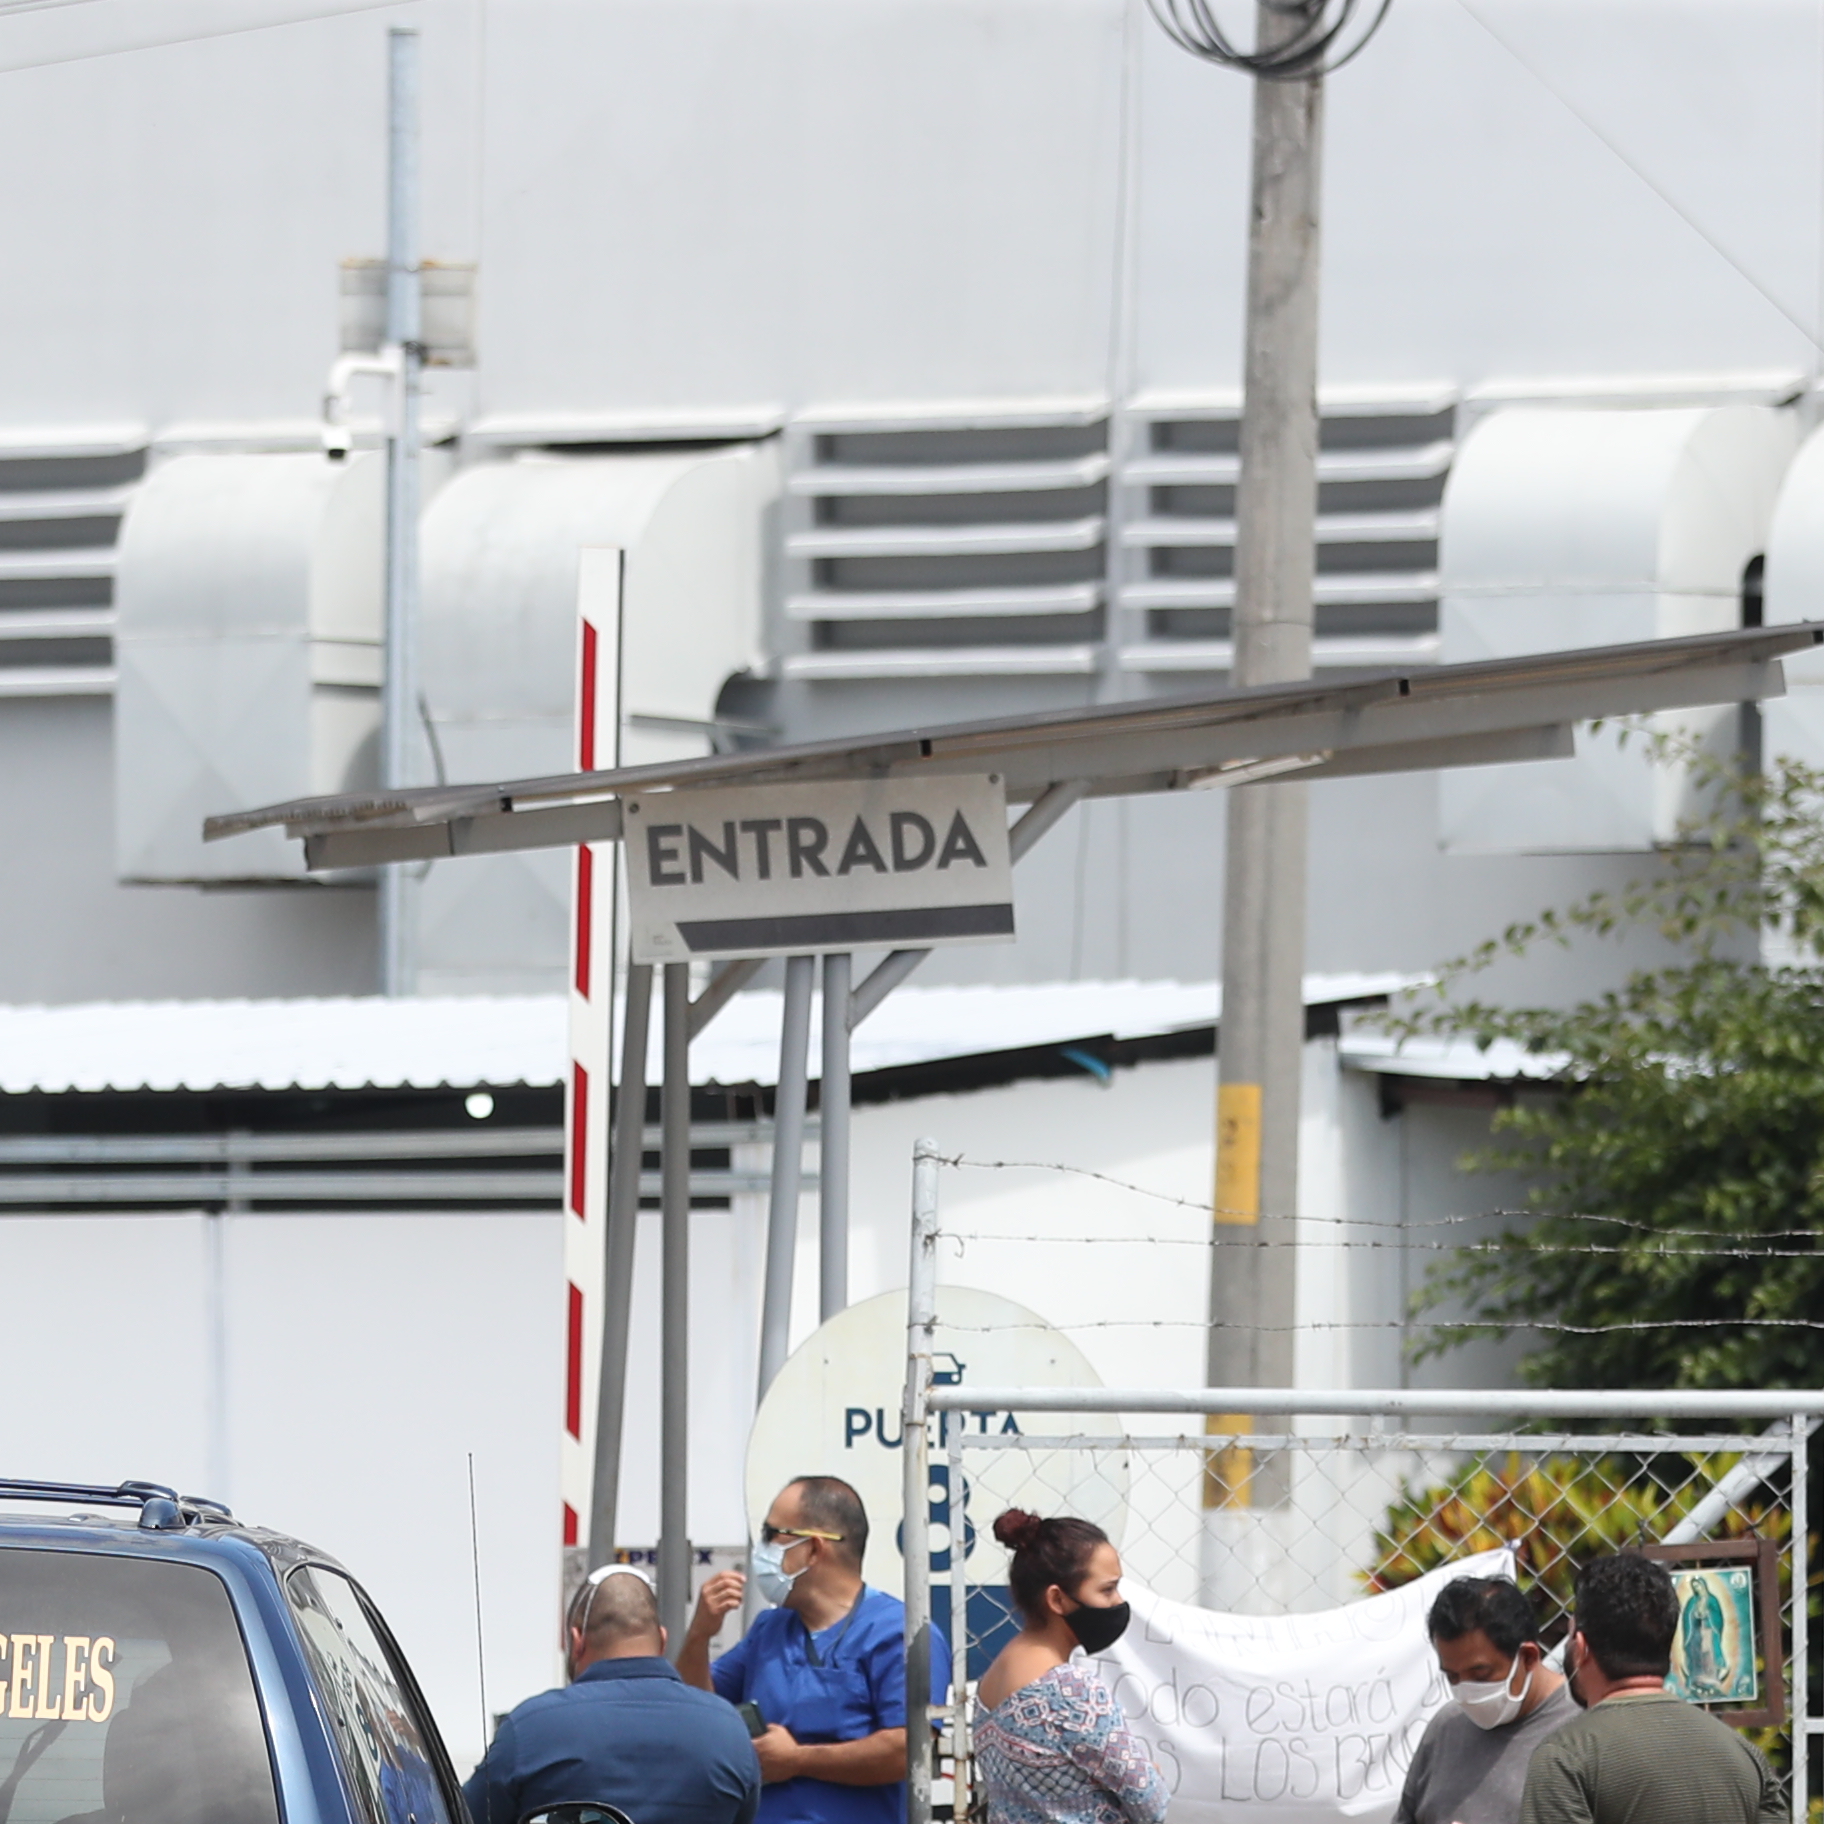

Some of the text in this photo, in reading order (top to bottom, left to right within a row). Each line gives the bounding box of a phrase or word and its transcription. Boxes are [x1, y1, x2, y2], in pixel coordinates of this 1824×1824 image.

[647, 809, 987, 887] ENTRADA
[1245, 1666, 1398, 1735] estará
[1221, 1736, 1319, 1801] LOS
